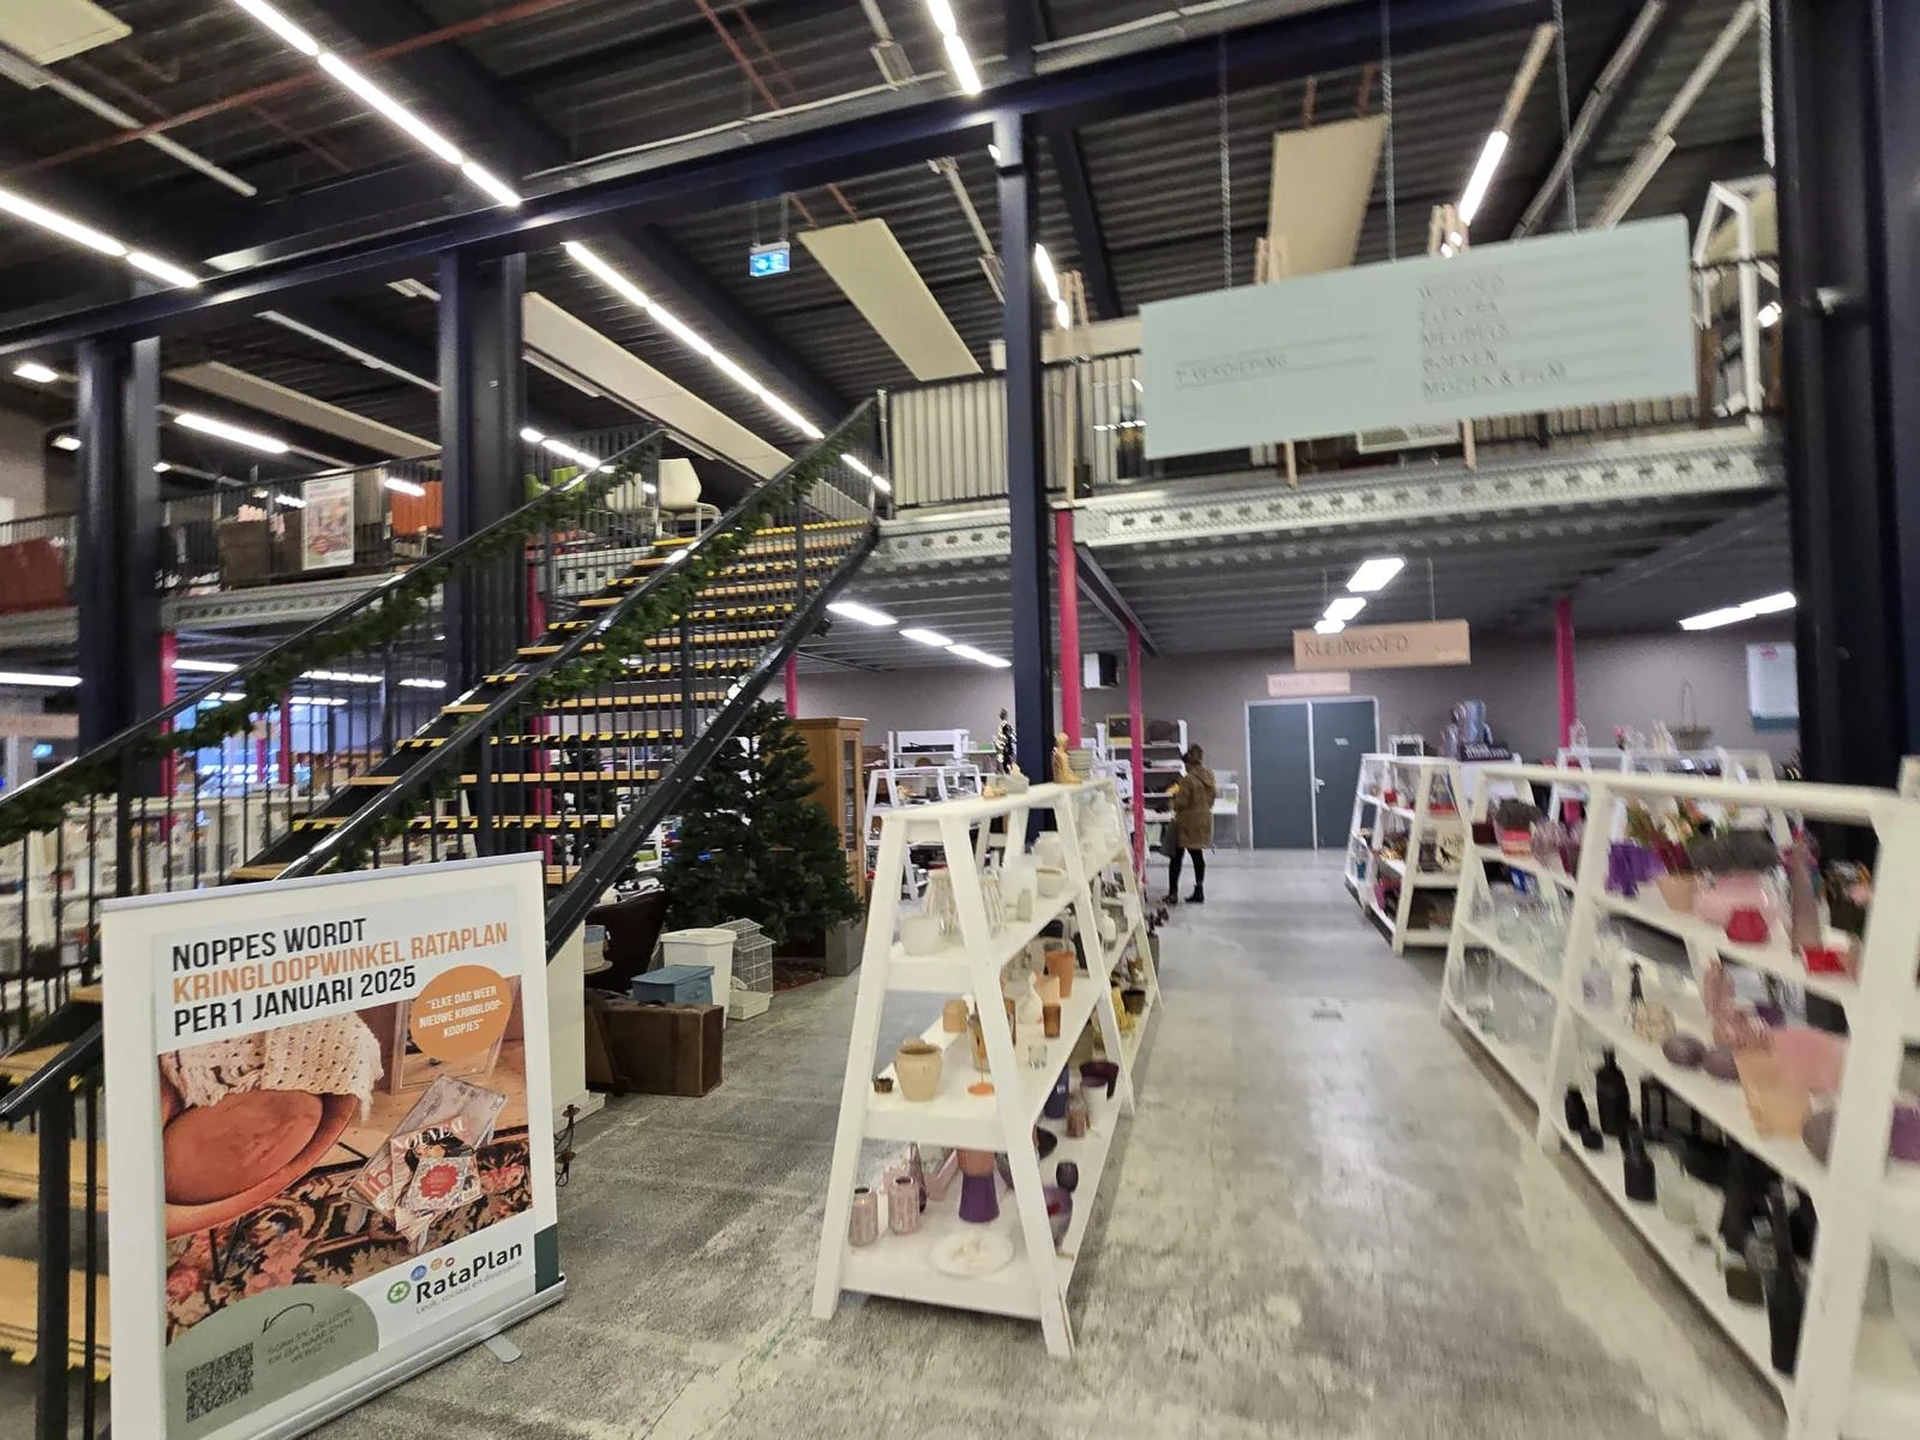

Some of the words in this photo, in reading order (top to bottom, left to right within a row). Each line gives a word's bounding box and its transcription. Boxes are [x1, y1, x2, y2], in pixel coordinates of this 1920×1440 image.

[173, 932, 276, 971] NOPPES
[284, 918, 367, 952] WORDT
[173, 940, 405, 1006] KRINGLOOPWINKEL
[411, 922, 508, 960] RATAPLAN
[252, 979, 353, 1021] JANUARI
[361, 965, 416, 999] 2025
[419, 1010, 454, 1029] NIEUWE
[454, 991, 473, 1004] DAG
[473, 985, 497, 1000] WEER
[416, 1243, 522, 1304] RataPlan
